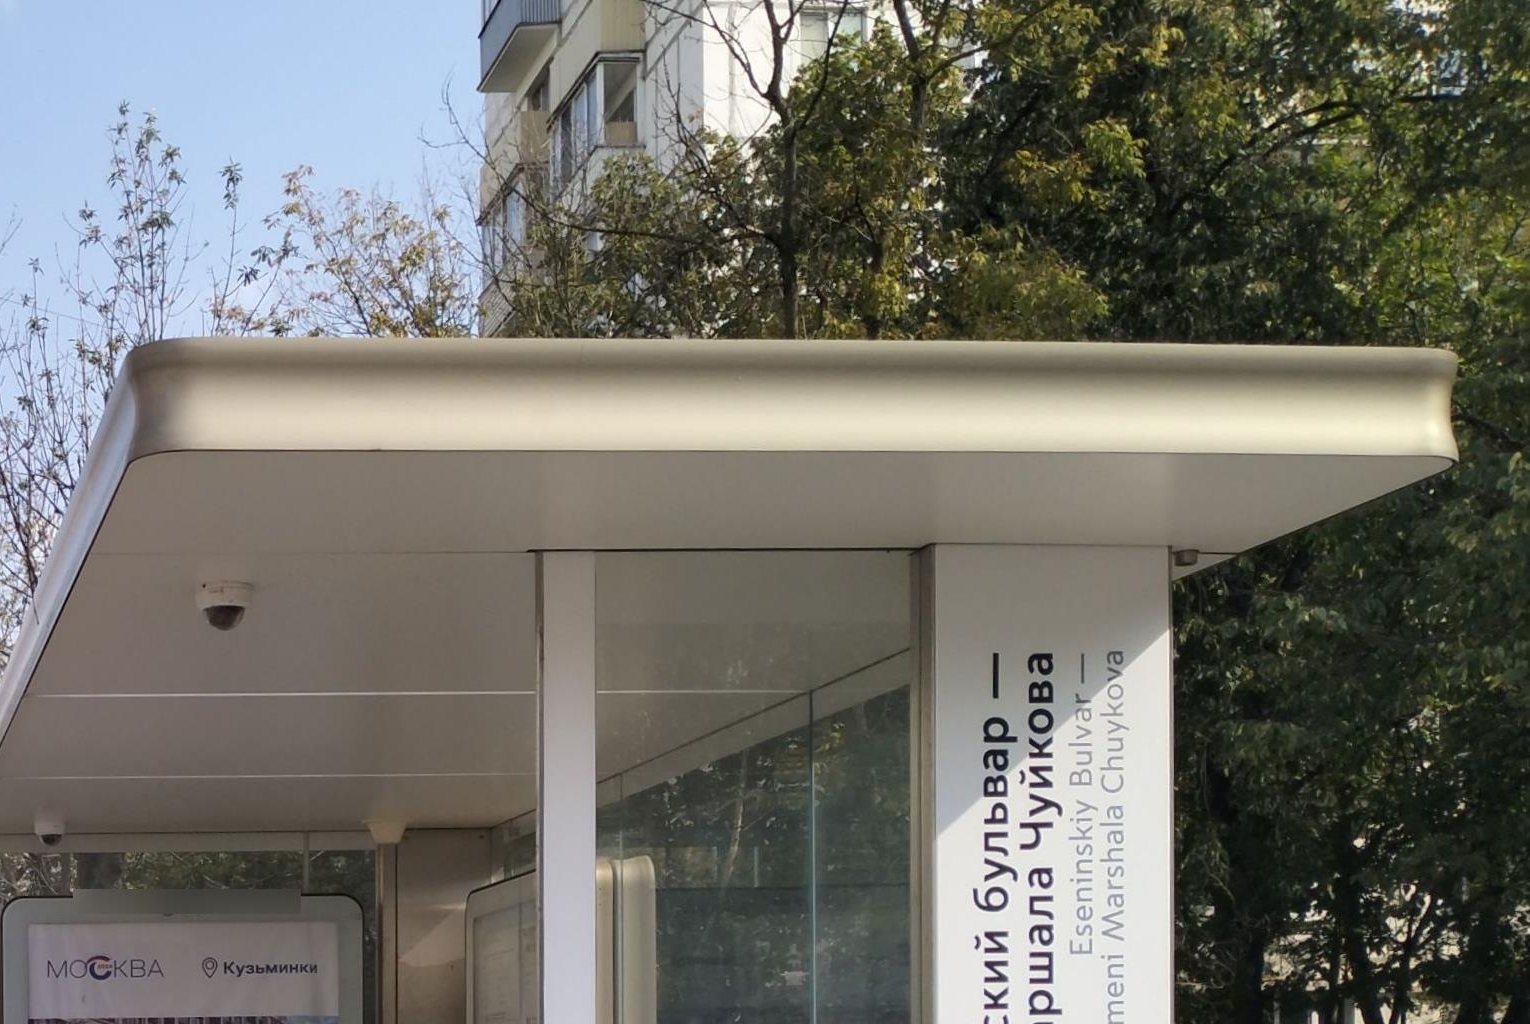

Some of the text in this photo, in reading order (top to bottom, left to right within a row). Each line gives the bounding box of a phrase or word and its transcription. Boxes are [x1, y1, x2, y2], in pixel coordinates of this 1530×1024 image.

[1019, 652, 1063, 850] Чуйкова
[1068, 693, 1093, 786] Bulvar
[1099, 650, 1130, 794] Chuykova
[972, 716, 1019, 912] бульвар
[1068, 800, 1098, 955] Eseninskiy
[1099, 805, 1125, 942] Marshala
[46, 955, 165, 981] МОСКВА
[223, 960, 319, 976] Кузьминки
